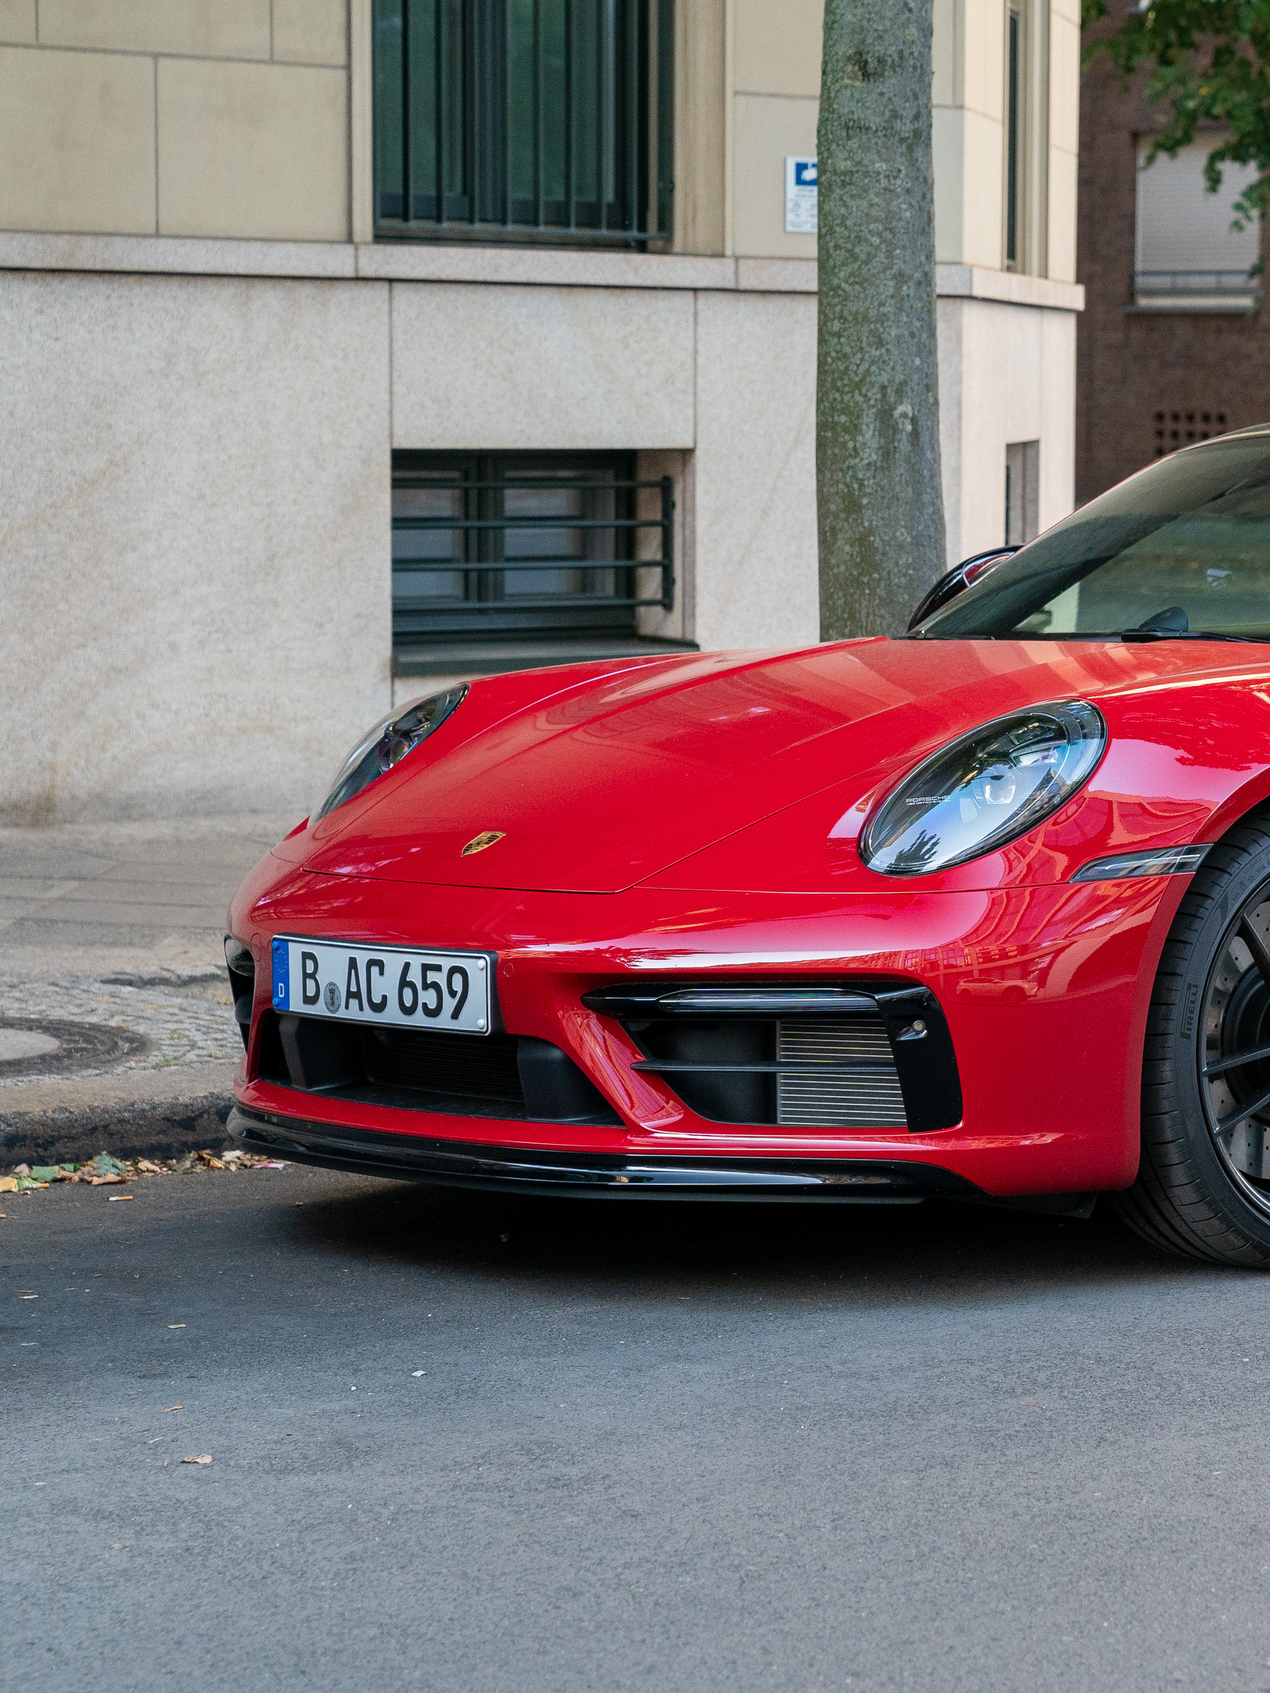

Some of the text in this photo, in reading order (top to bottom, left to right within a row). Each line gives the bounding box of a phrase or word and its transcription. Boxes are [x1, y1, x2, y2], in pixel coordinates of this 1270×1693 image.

[277, 982, 285, 998] D
[301, 950, 320, 1006] B
[344, 956, 389, 1014] AC
[397, 961, 470, 1020] 659
[1180, 982, 1200, 1040] PIRELLI
